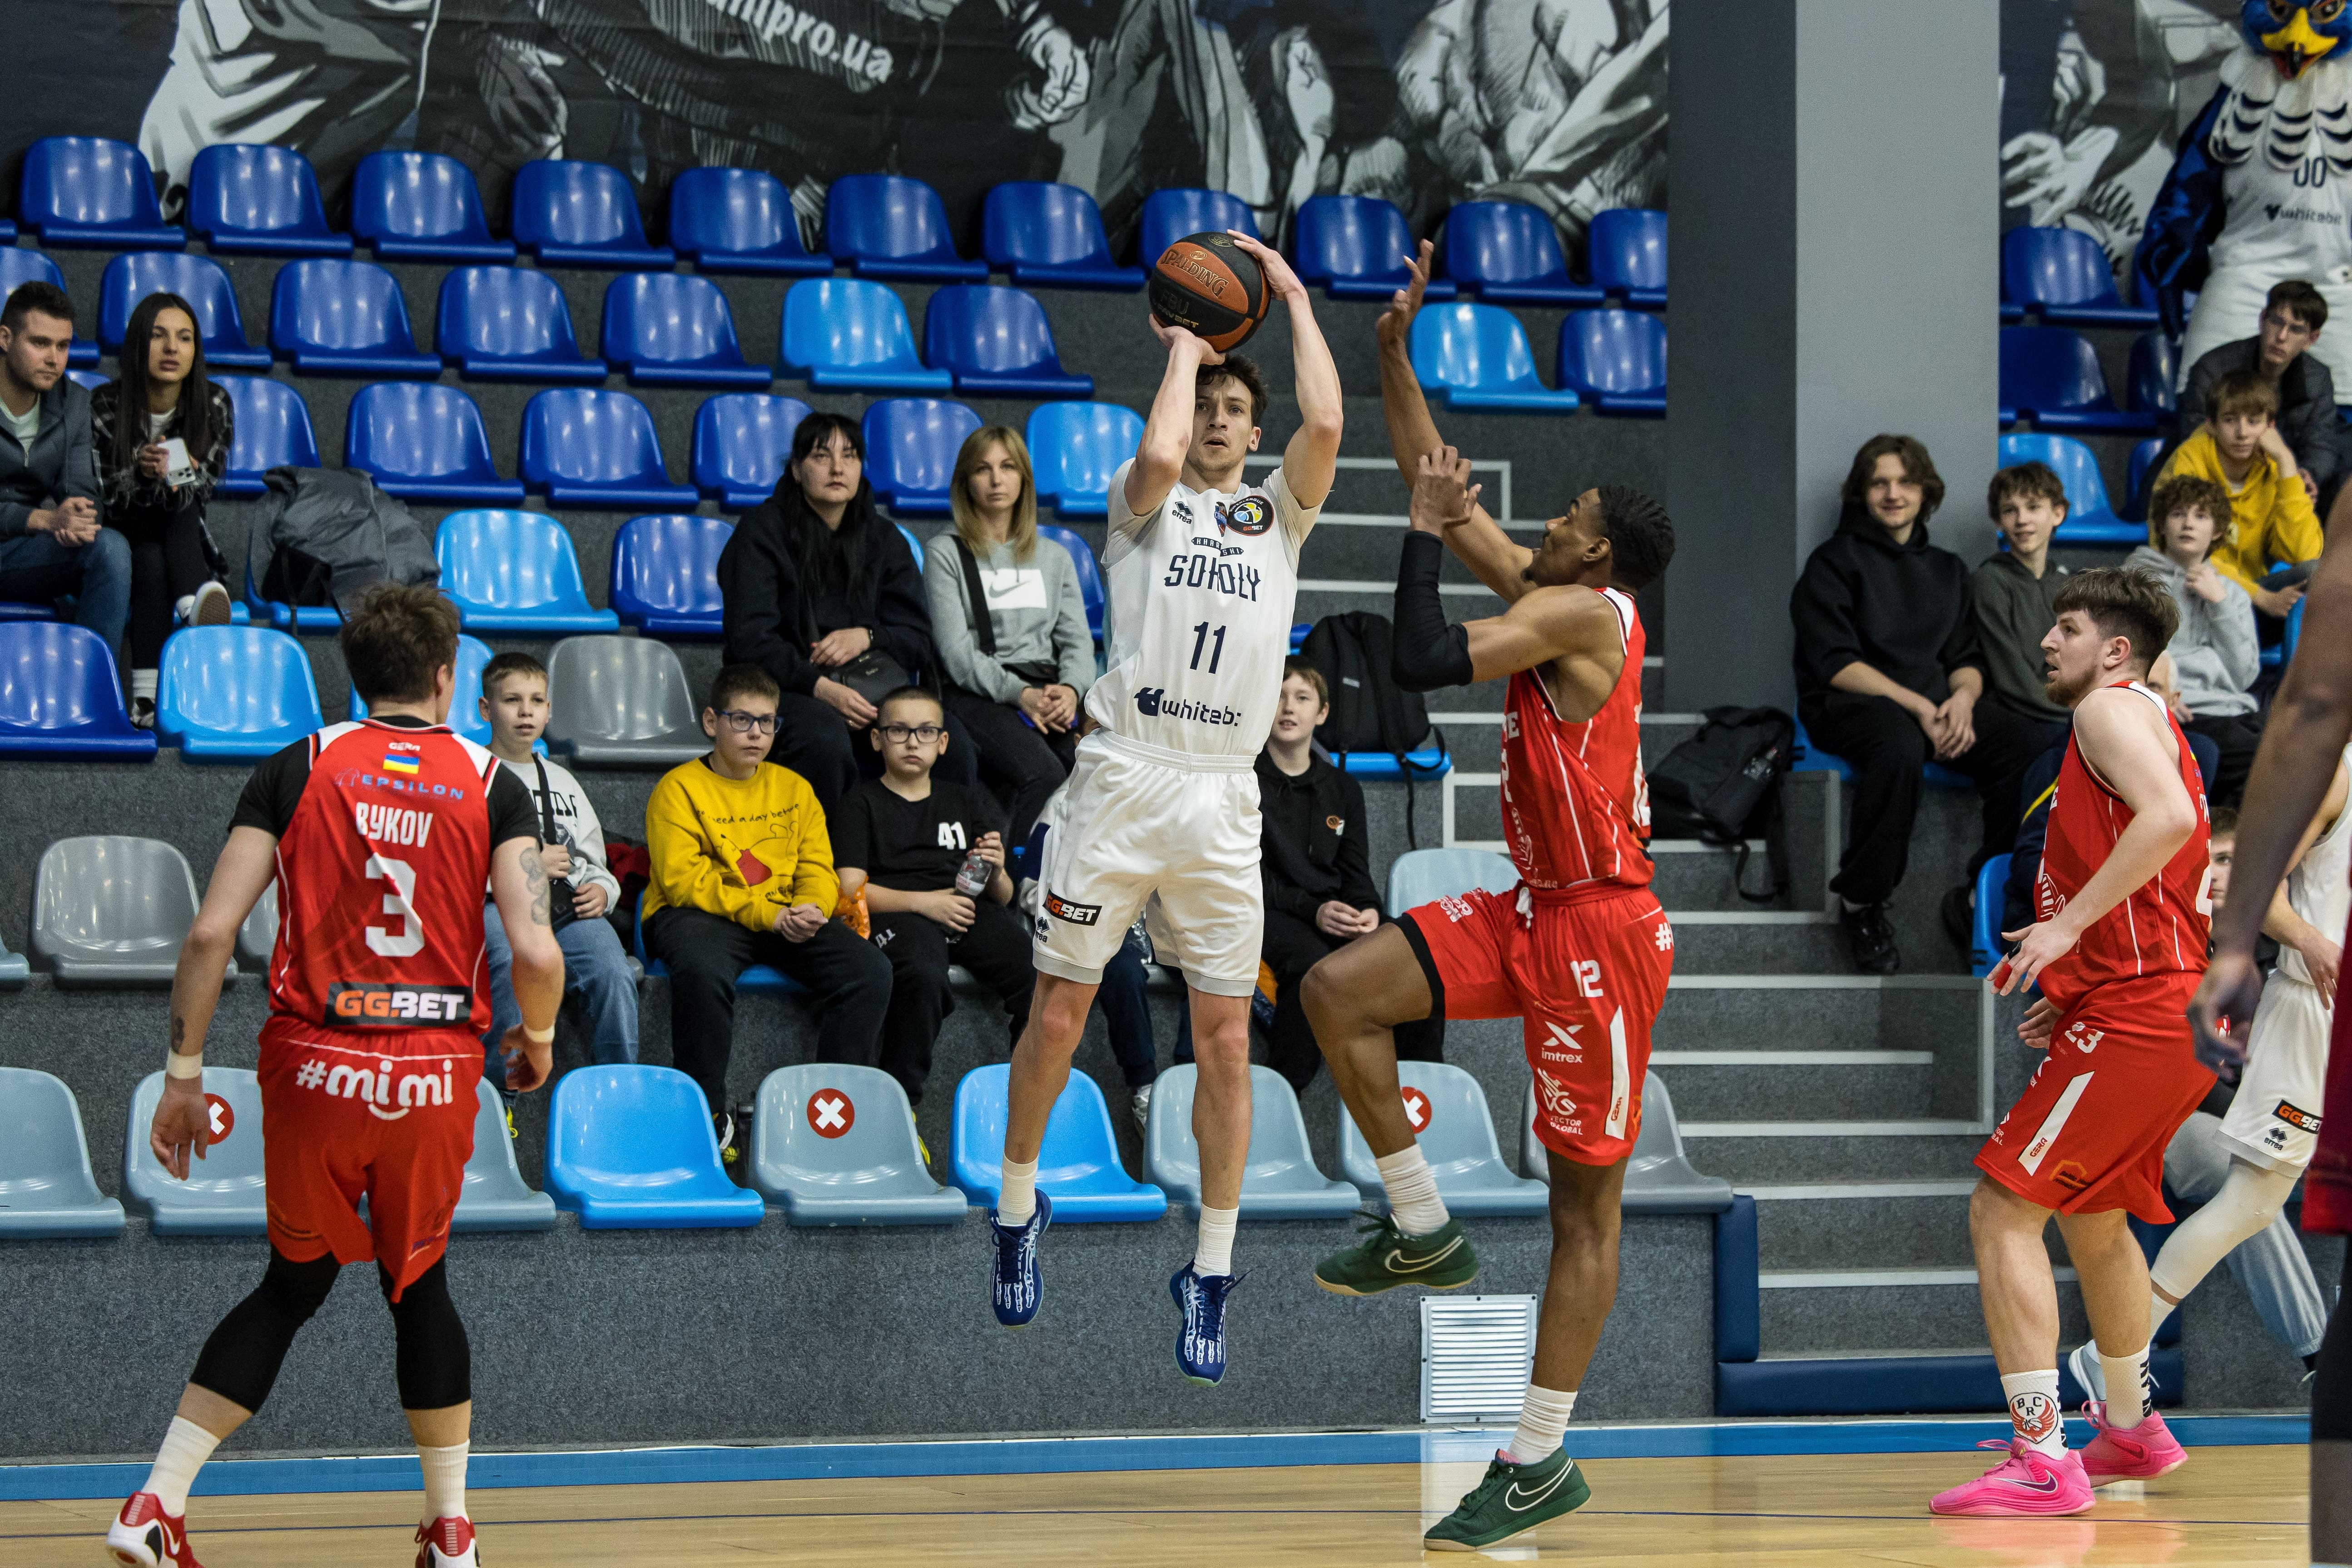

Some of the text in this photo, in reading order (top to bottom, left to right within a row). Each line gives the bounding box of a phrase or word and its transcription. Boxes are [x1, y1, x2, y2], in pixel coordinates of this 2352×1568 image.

[1161, 249, 1229, 298] SPALDING
[1190, 621, 1226, 674] 11
[362, 774, 464, 800] EPSILON
[356, 802, 433, 848] BYKOV
[938, 821, 967, 850] 41
[365, 852, 425, 957] 3
[1570, 959, 1603, 998] 12
[1541, 1047, 1583, 1063] imtrex
[2064, 1022, 2105, 1054] 23
[2029, 1137, 2048, 1157] GERA
